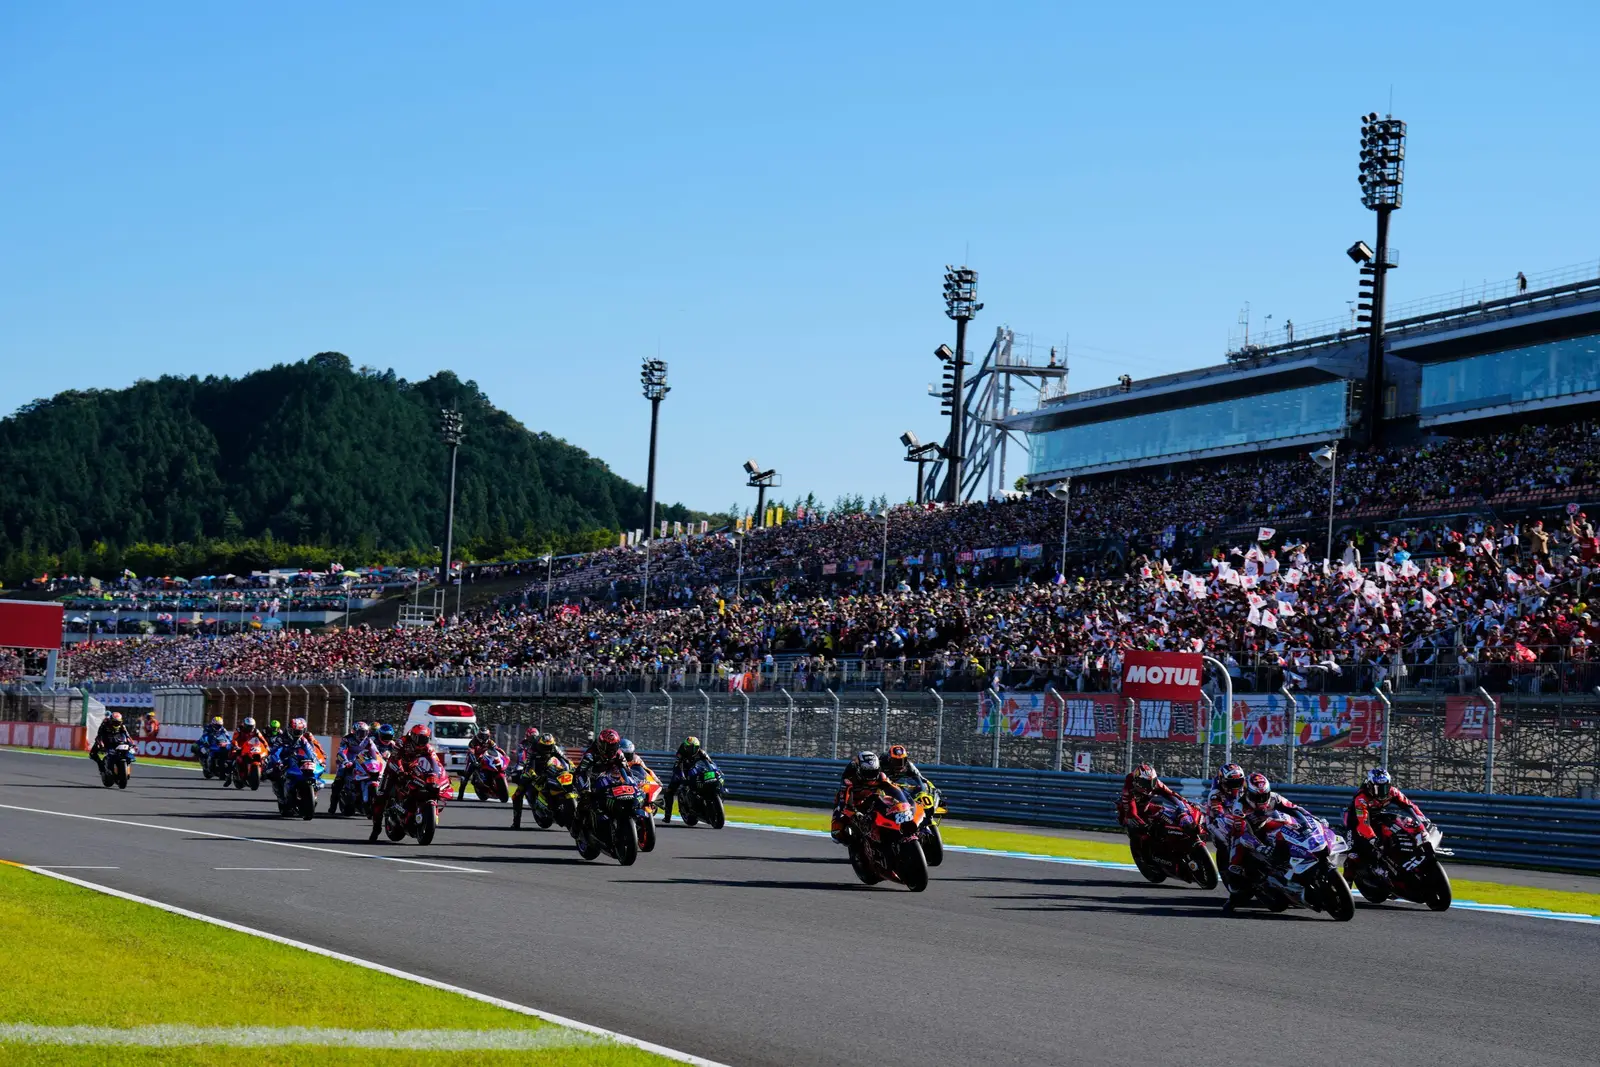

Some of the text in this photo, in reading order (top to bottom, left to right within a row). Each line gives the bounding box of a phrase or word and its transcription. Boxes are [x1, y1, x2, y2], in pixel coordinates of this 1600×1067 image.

[1125, 665, 1200, 686] MOTUL
[1461, 705, 1487, 729] 93
[1152, 854, 1173, 867] Lenovo
